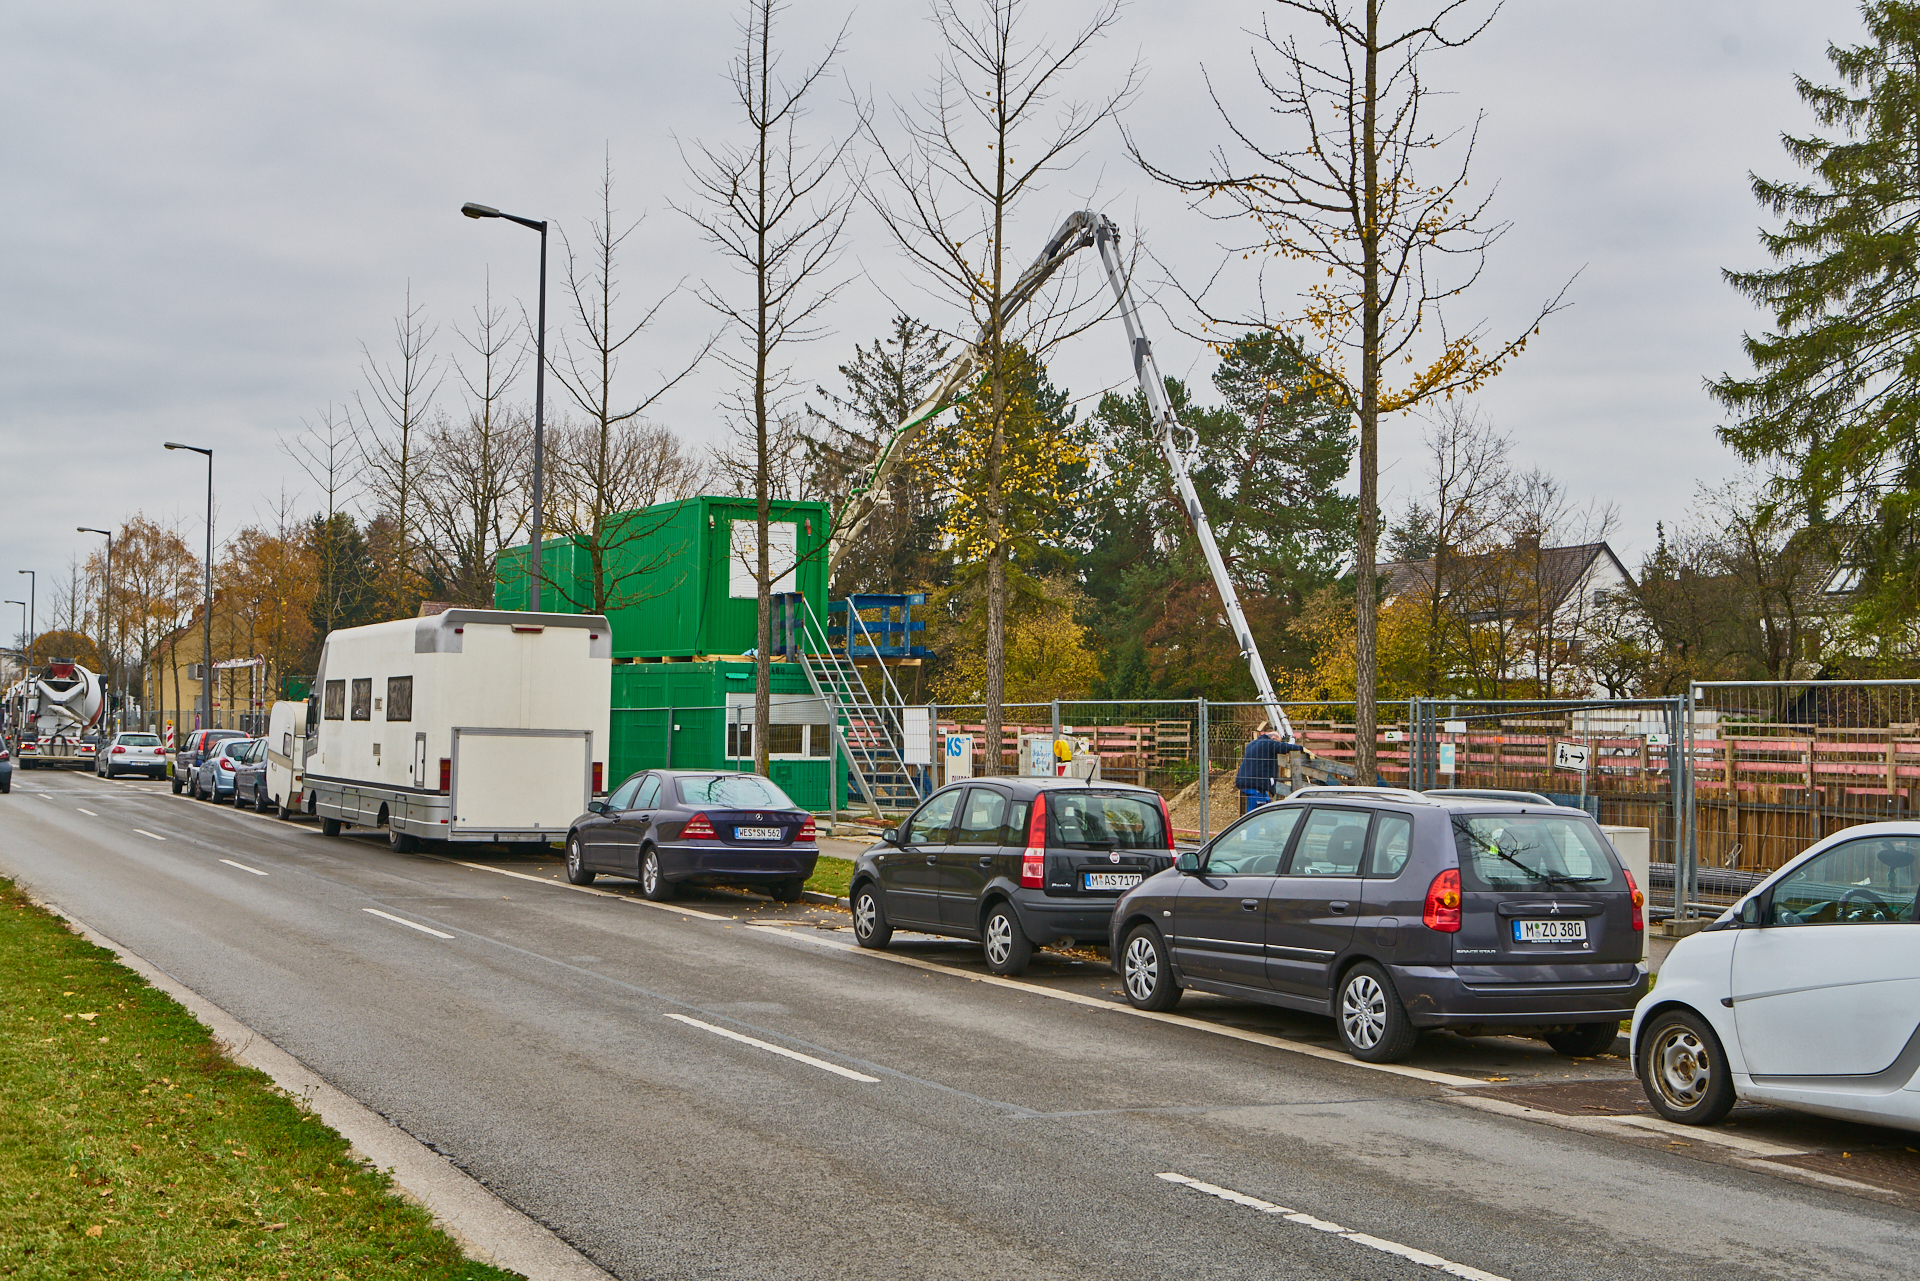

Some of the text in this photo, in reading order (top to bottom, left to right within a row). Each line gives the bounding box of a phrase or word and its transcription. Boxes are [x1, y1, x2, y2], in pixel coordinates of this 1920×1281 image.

[947, 737, 961, 756] KS
[739, 828, 780, 837] WES SN 562
[1091, 875, 1141, 886] M AS 7177
[1526, 922, 1581, 938] M ZO 380
